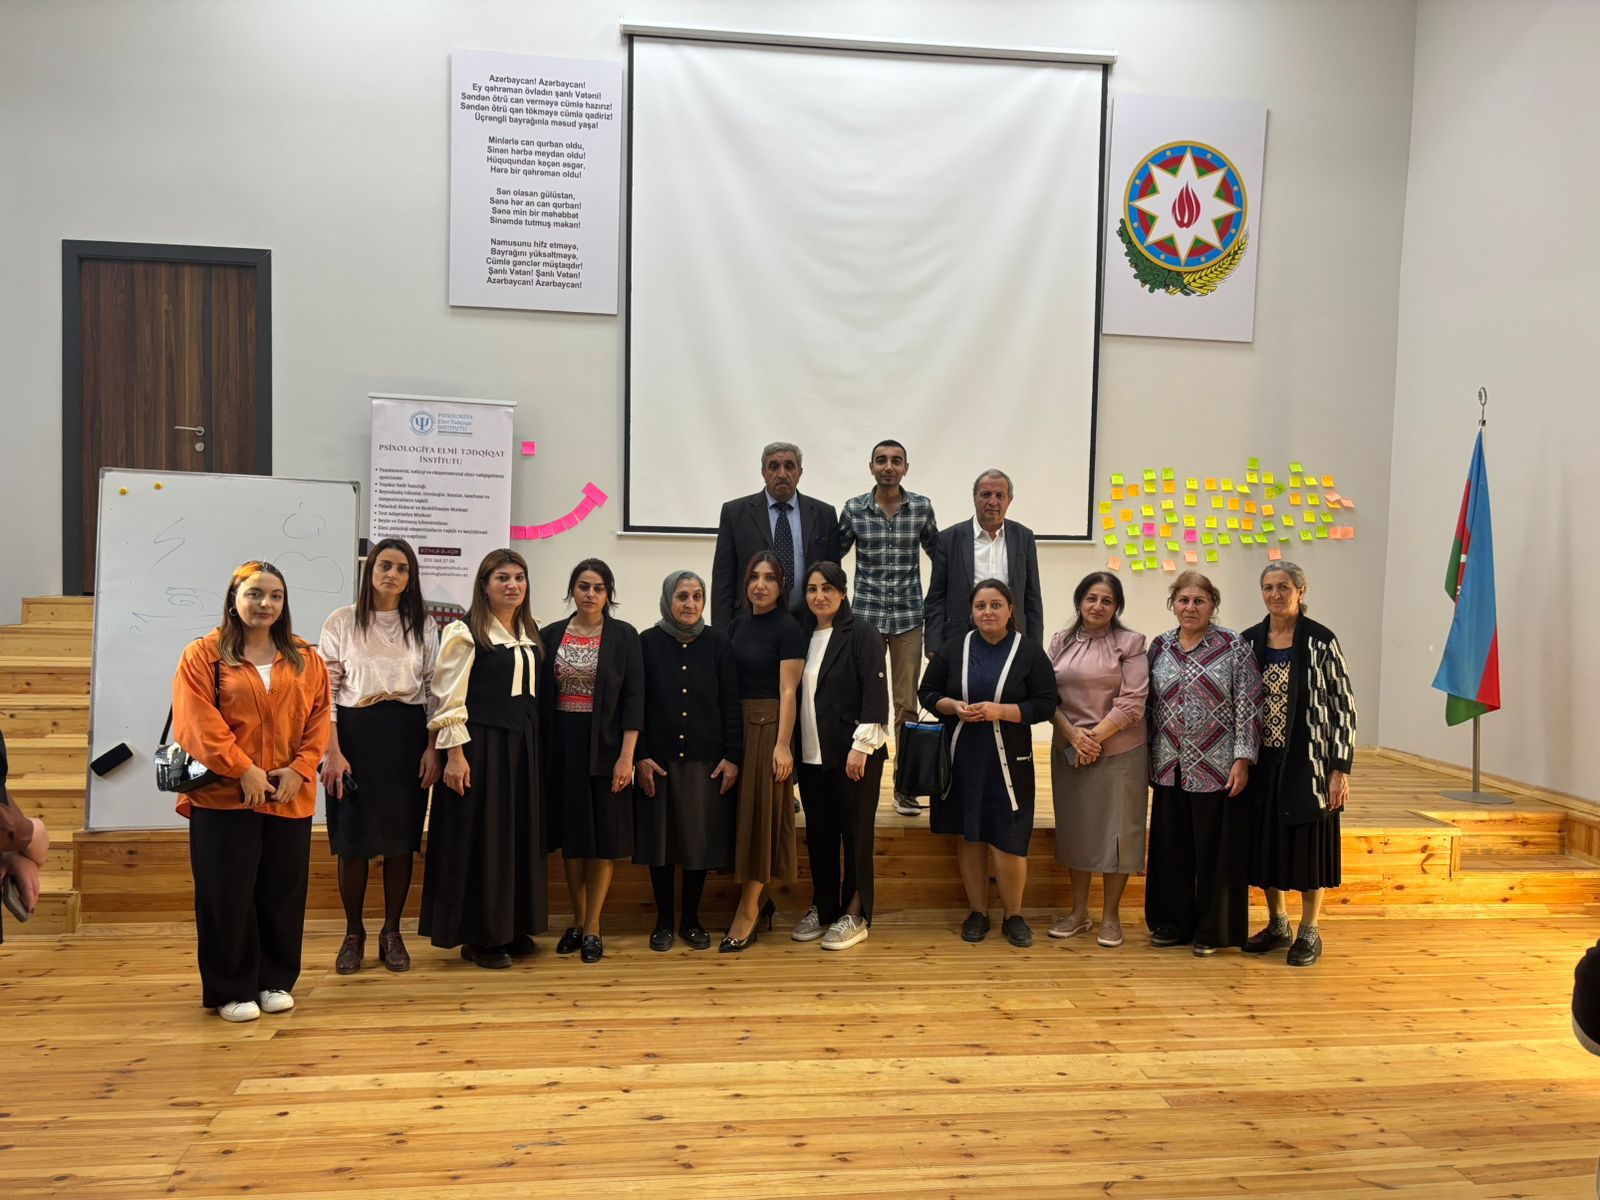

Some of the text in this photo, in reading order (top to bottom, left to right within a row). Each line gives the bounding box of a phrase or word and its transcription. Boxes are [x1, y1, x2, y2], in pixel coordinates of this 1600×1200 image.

[488, 74, 585, 89] Azərbaycan! Azərbaycan!
[472, 82, 482, 92] Ey
[484, 84, 522, 94] qəhrəman
[574, 90, 601, 99] Vətəni!
[460, 91, 490, 101] Səndən
[492, 94, 508, 102] ötrü
[525, 98, 558, 108] verməyə
[560, 100, 583, 108] cümlə
[460, 101, 489, 111] Səndən
[491, 104, 507, 112] ötrü
[525, 107, 558, 117] tökməyə
[584, 112, 612, 120] qadiriz!
[474, 112, 506, 124] Üçrəngli
[578, 121, 598, 130] yaşa!
[486, 145, 508, 154] Sinən
[510, 147, 532, 156] hərbə
[534, 150, 564, 158] meydan
[536, 140, 563, 148] qurban
[565, 141, 584, 150] oldu,
[537, 158, 560, 168] keçən
[490, 165, 508, 173] Hərə
[522, 168, 560, 176] qəhrəman
[496, 187, 510, 195] Sən
[540, 190, 575, 200] gülüstan,
[489, 196, 509, 205] Sənə
[552, 201, 581, 209] qurban!
[491, 206, 511, 215] Sənə
[541, 210, 578, 219] məhəbbət
[489, 216, 523, 225] Sinəmdə
[524, 219, 551, 228] tutmuş
[490, 238, 531, 247] Namusunu
[549, 242, 578, 251] etməyə,
[485, 256, 510, 265] Cümlə
[512, 259, 540, 267] gənclər
[488, 266, 580, 278] Şanlı Vətən! Şanlı Vətən!
[486, 276, 582, 289] Azərbaycan! Azərbaycan!
[378, 443, 435, 453] PSİXOLOGİYA
[419, 455, 463, 464] İNSTİTUTU
